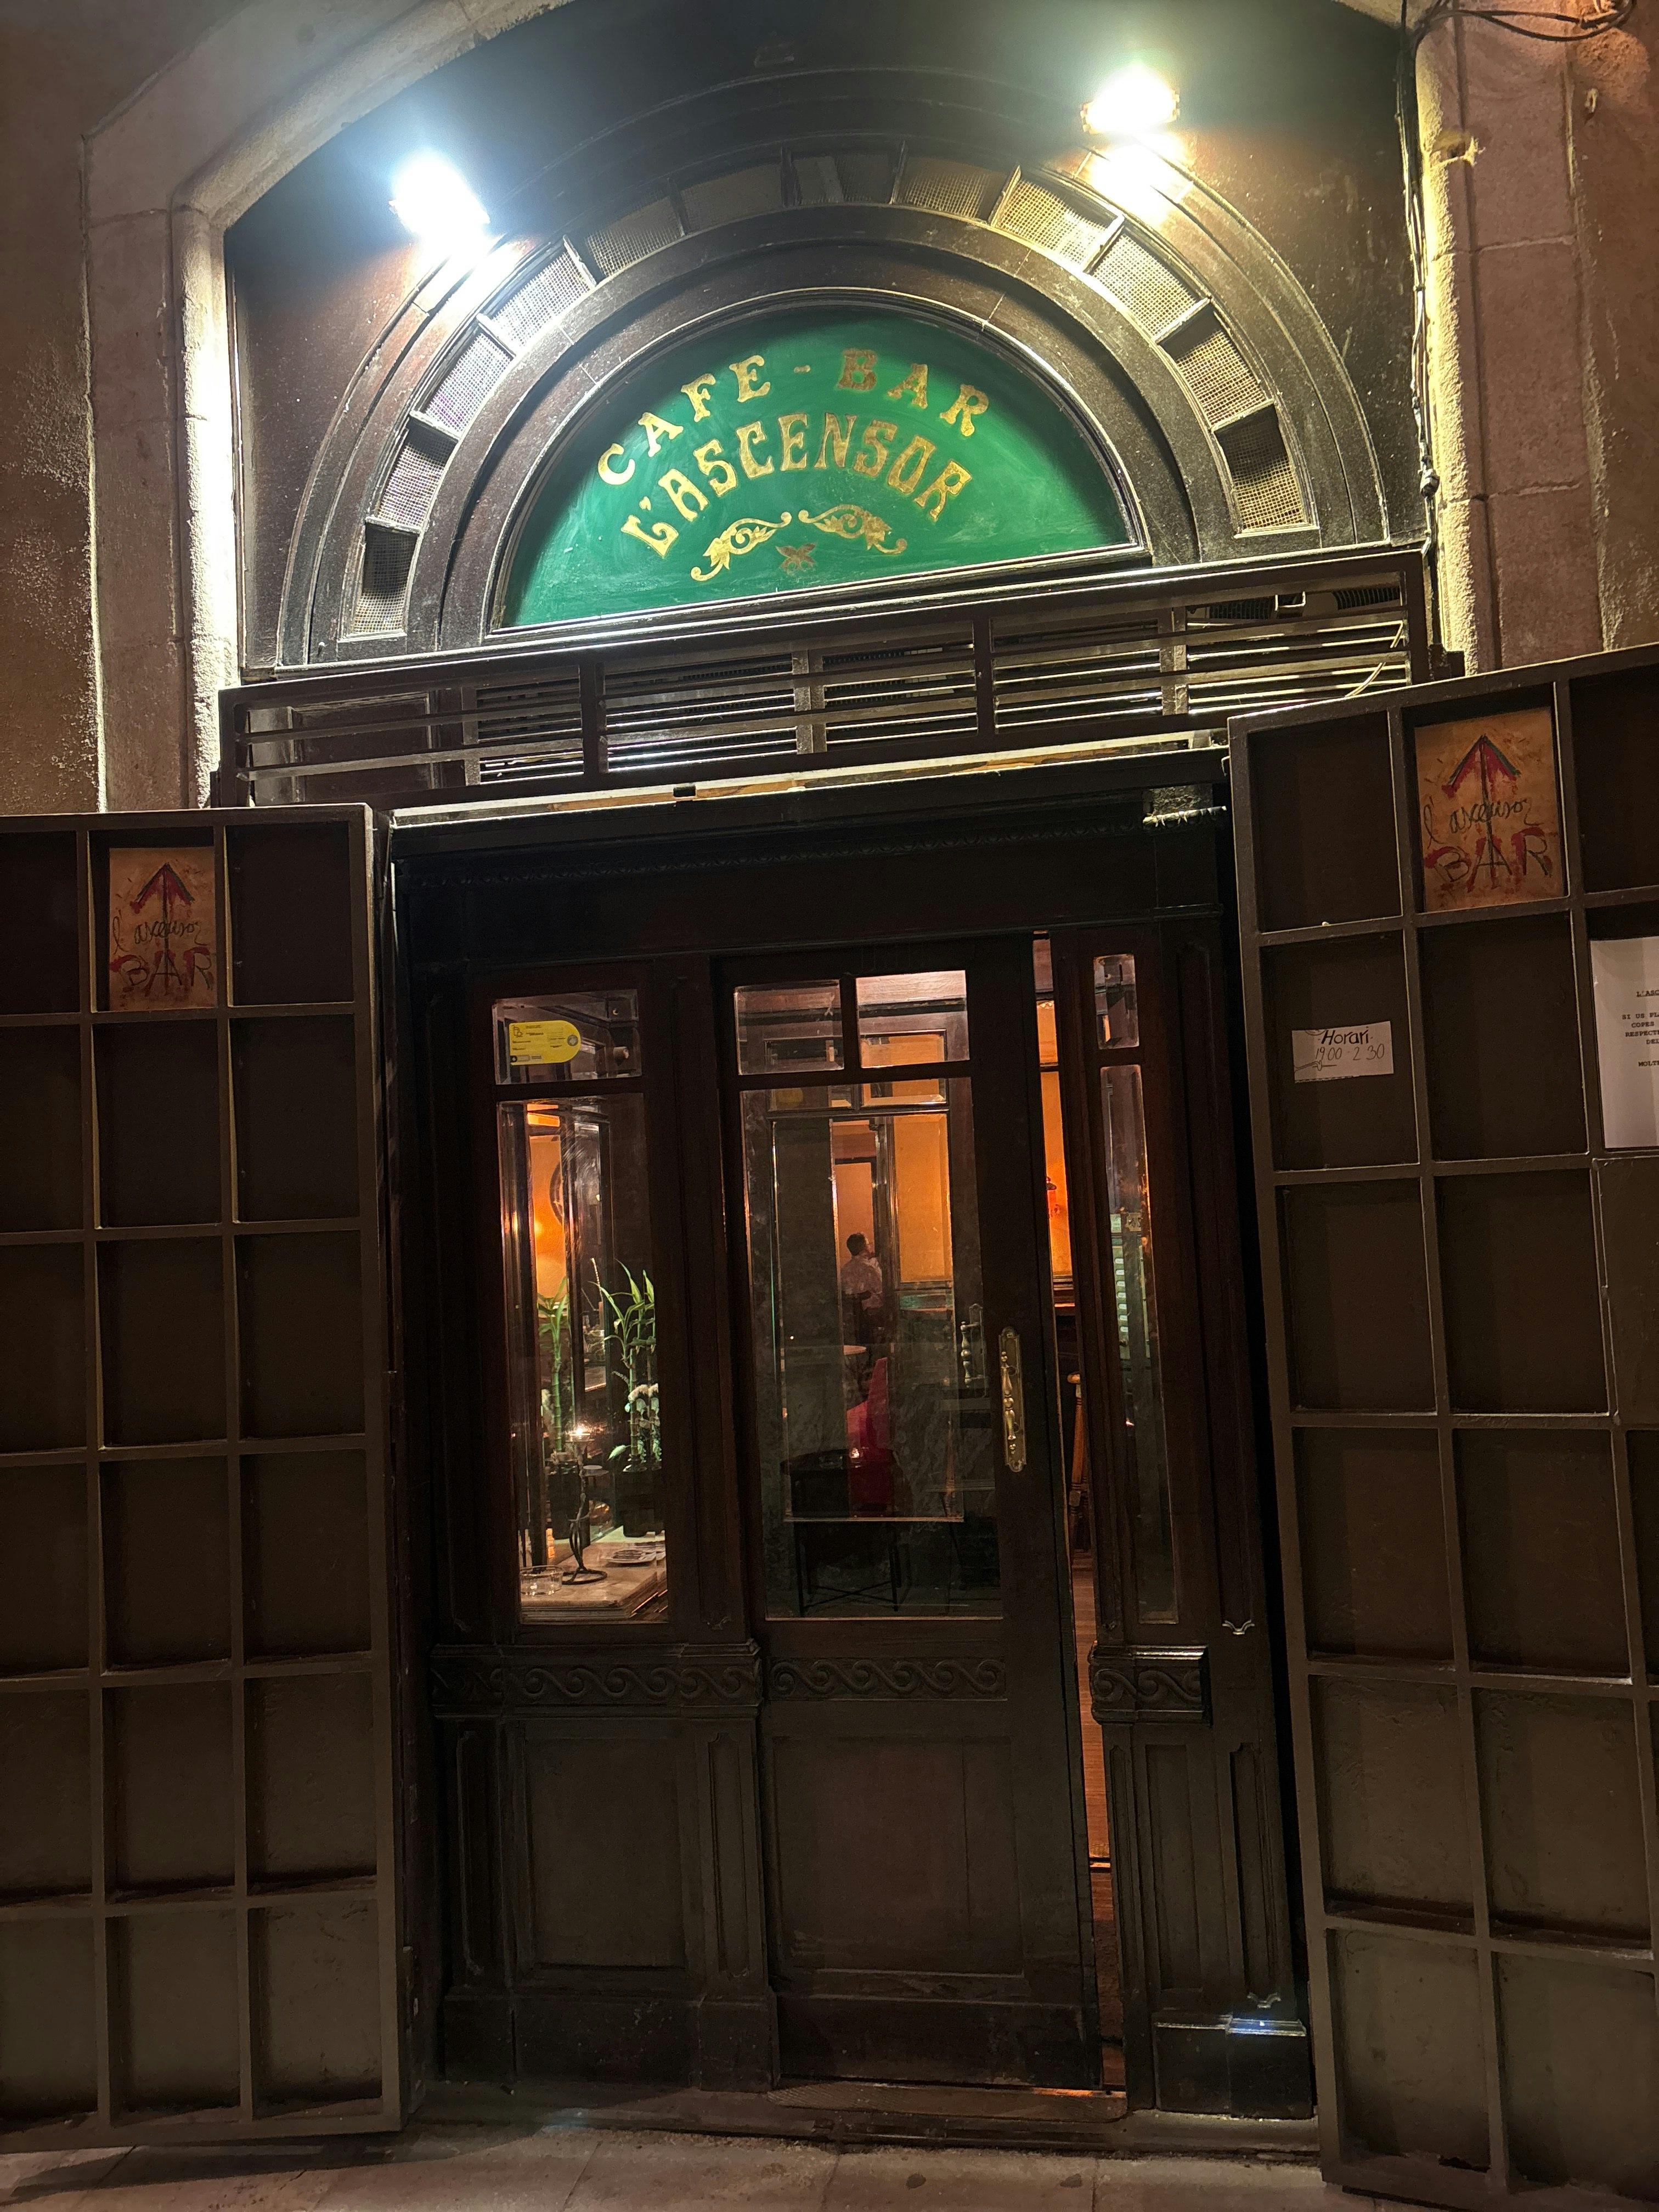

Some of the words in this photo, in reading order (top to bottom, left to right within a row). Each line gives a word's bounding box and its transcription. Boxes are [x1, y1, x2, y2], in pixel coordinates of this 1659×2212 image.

[597, 354, 771, 486] CAFE
[837, 347, 990, 438] BAR
[621, 411, 973, 558] L'ASCENSOR
[1424, 827, 1553, 893] BAR
[110, 946, 213, 997] BAR
[1321, 1026, 1369, 1045] Horari
